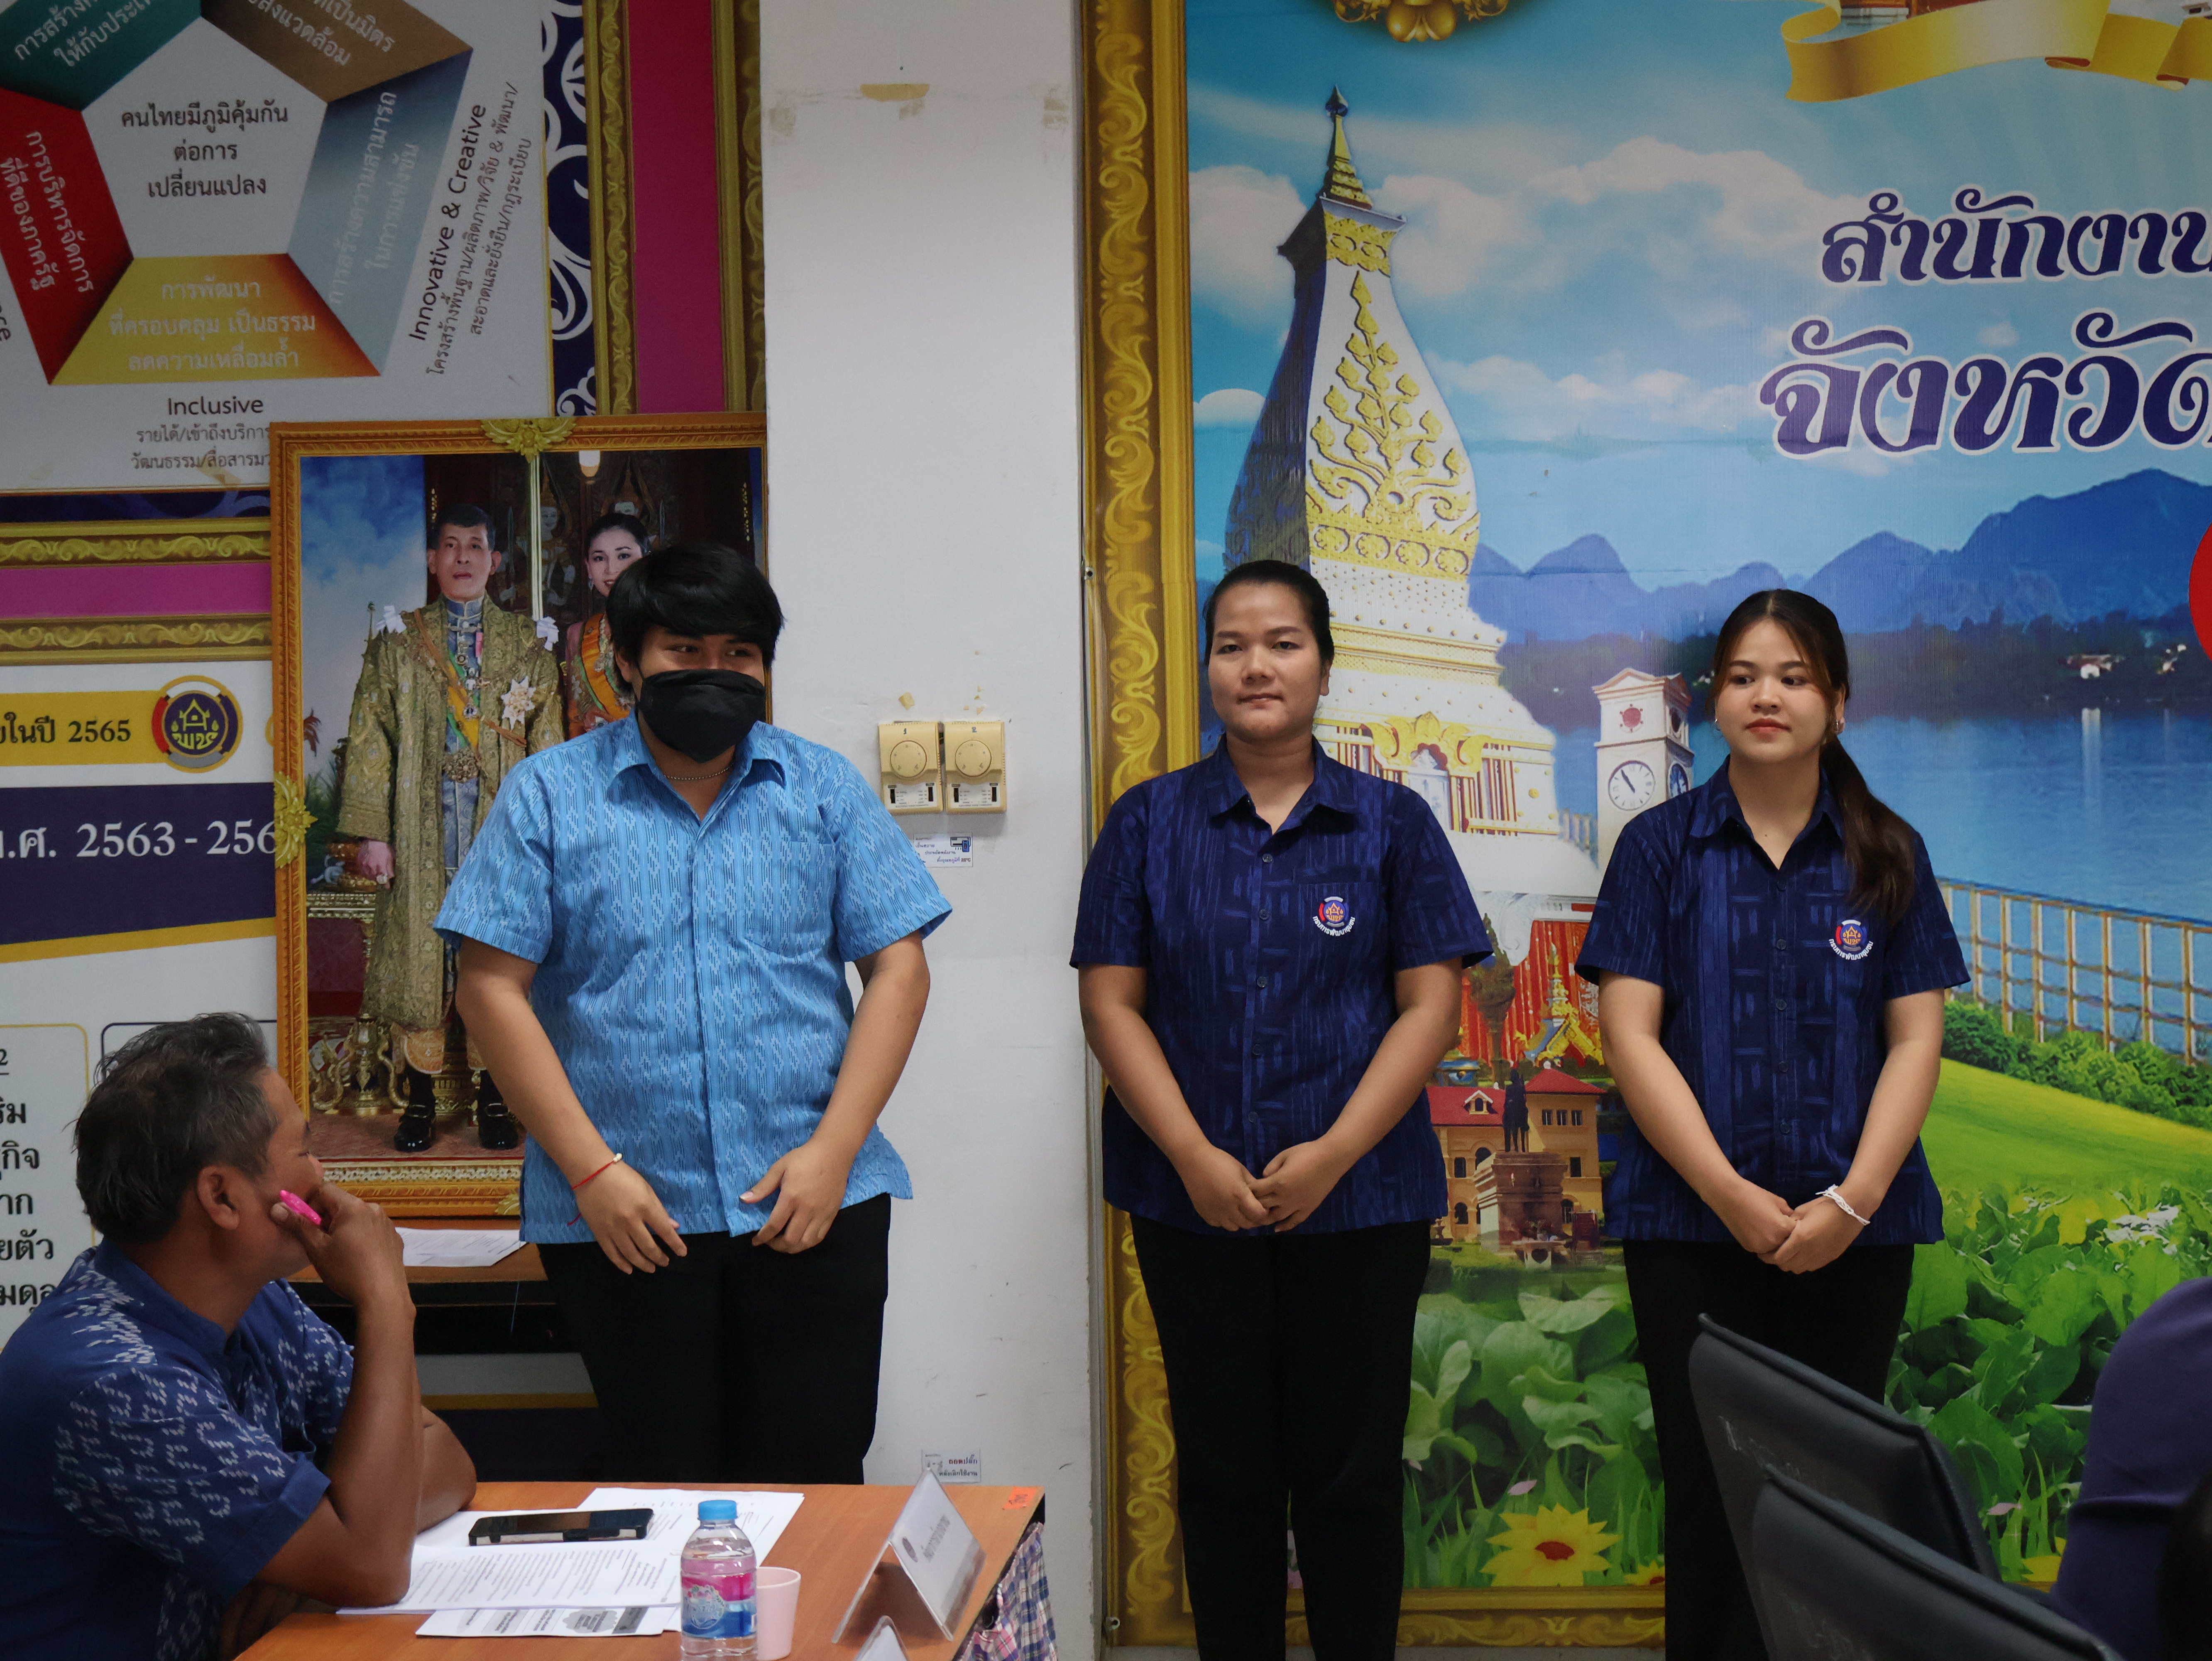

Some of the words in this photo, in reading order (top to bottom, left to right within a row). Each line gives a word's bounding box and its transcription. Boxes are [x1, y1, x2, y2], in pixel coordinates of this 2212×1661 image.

[121, 99, 288, 133] คนไทยมีภูมิคุ้มกัน
[174, 139, 237, 161] ต่อการ
[448, 104, 486, 194] Creative
[489, 138, 504, 153] &
[148, 168, 267, 198] เปลี่ยนแปลง
[330, 92, 397, 304] การสร้างความสามารถ
[0, 157, 59, 290] ที่ดีของภาครัฐ
[26, 132, 93, 292] การบริหารจัดการ
[442, 203, 461, 219] &
[161, 274, 261, 300] การพัฒนา
[409, 226, 454, 341] Innovative
[109, 308, 220, 341] ที่ครอบคลุม
[229, 308, 316, 333] เป็นธรรม
[129, 337, 299, 371] ลดความเหลื่อมล้ำ
[168, 396, 264, 415] Inclusive
[69, 719, 131, 742] 2565
[76, 821, 176, 858] 2563
[1313, 915, 1356, 936] กรมการพัฒนาชุมชน
[1829, 938, 1874, 960] กรมการพัฒนาชุมชน
